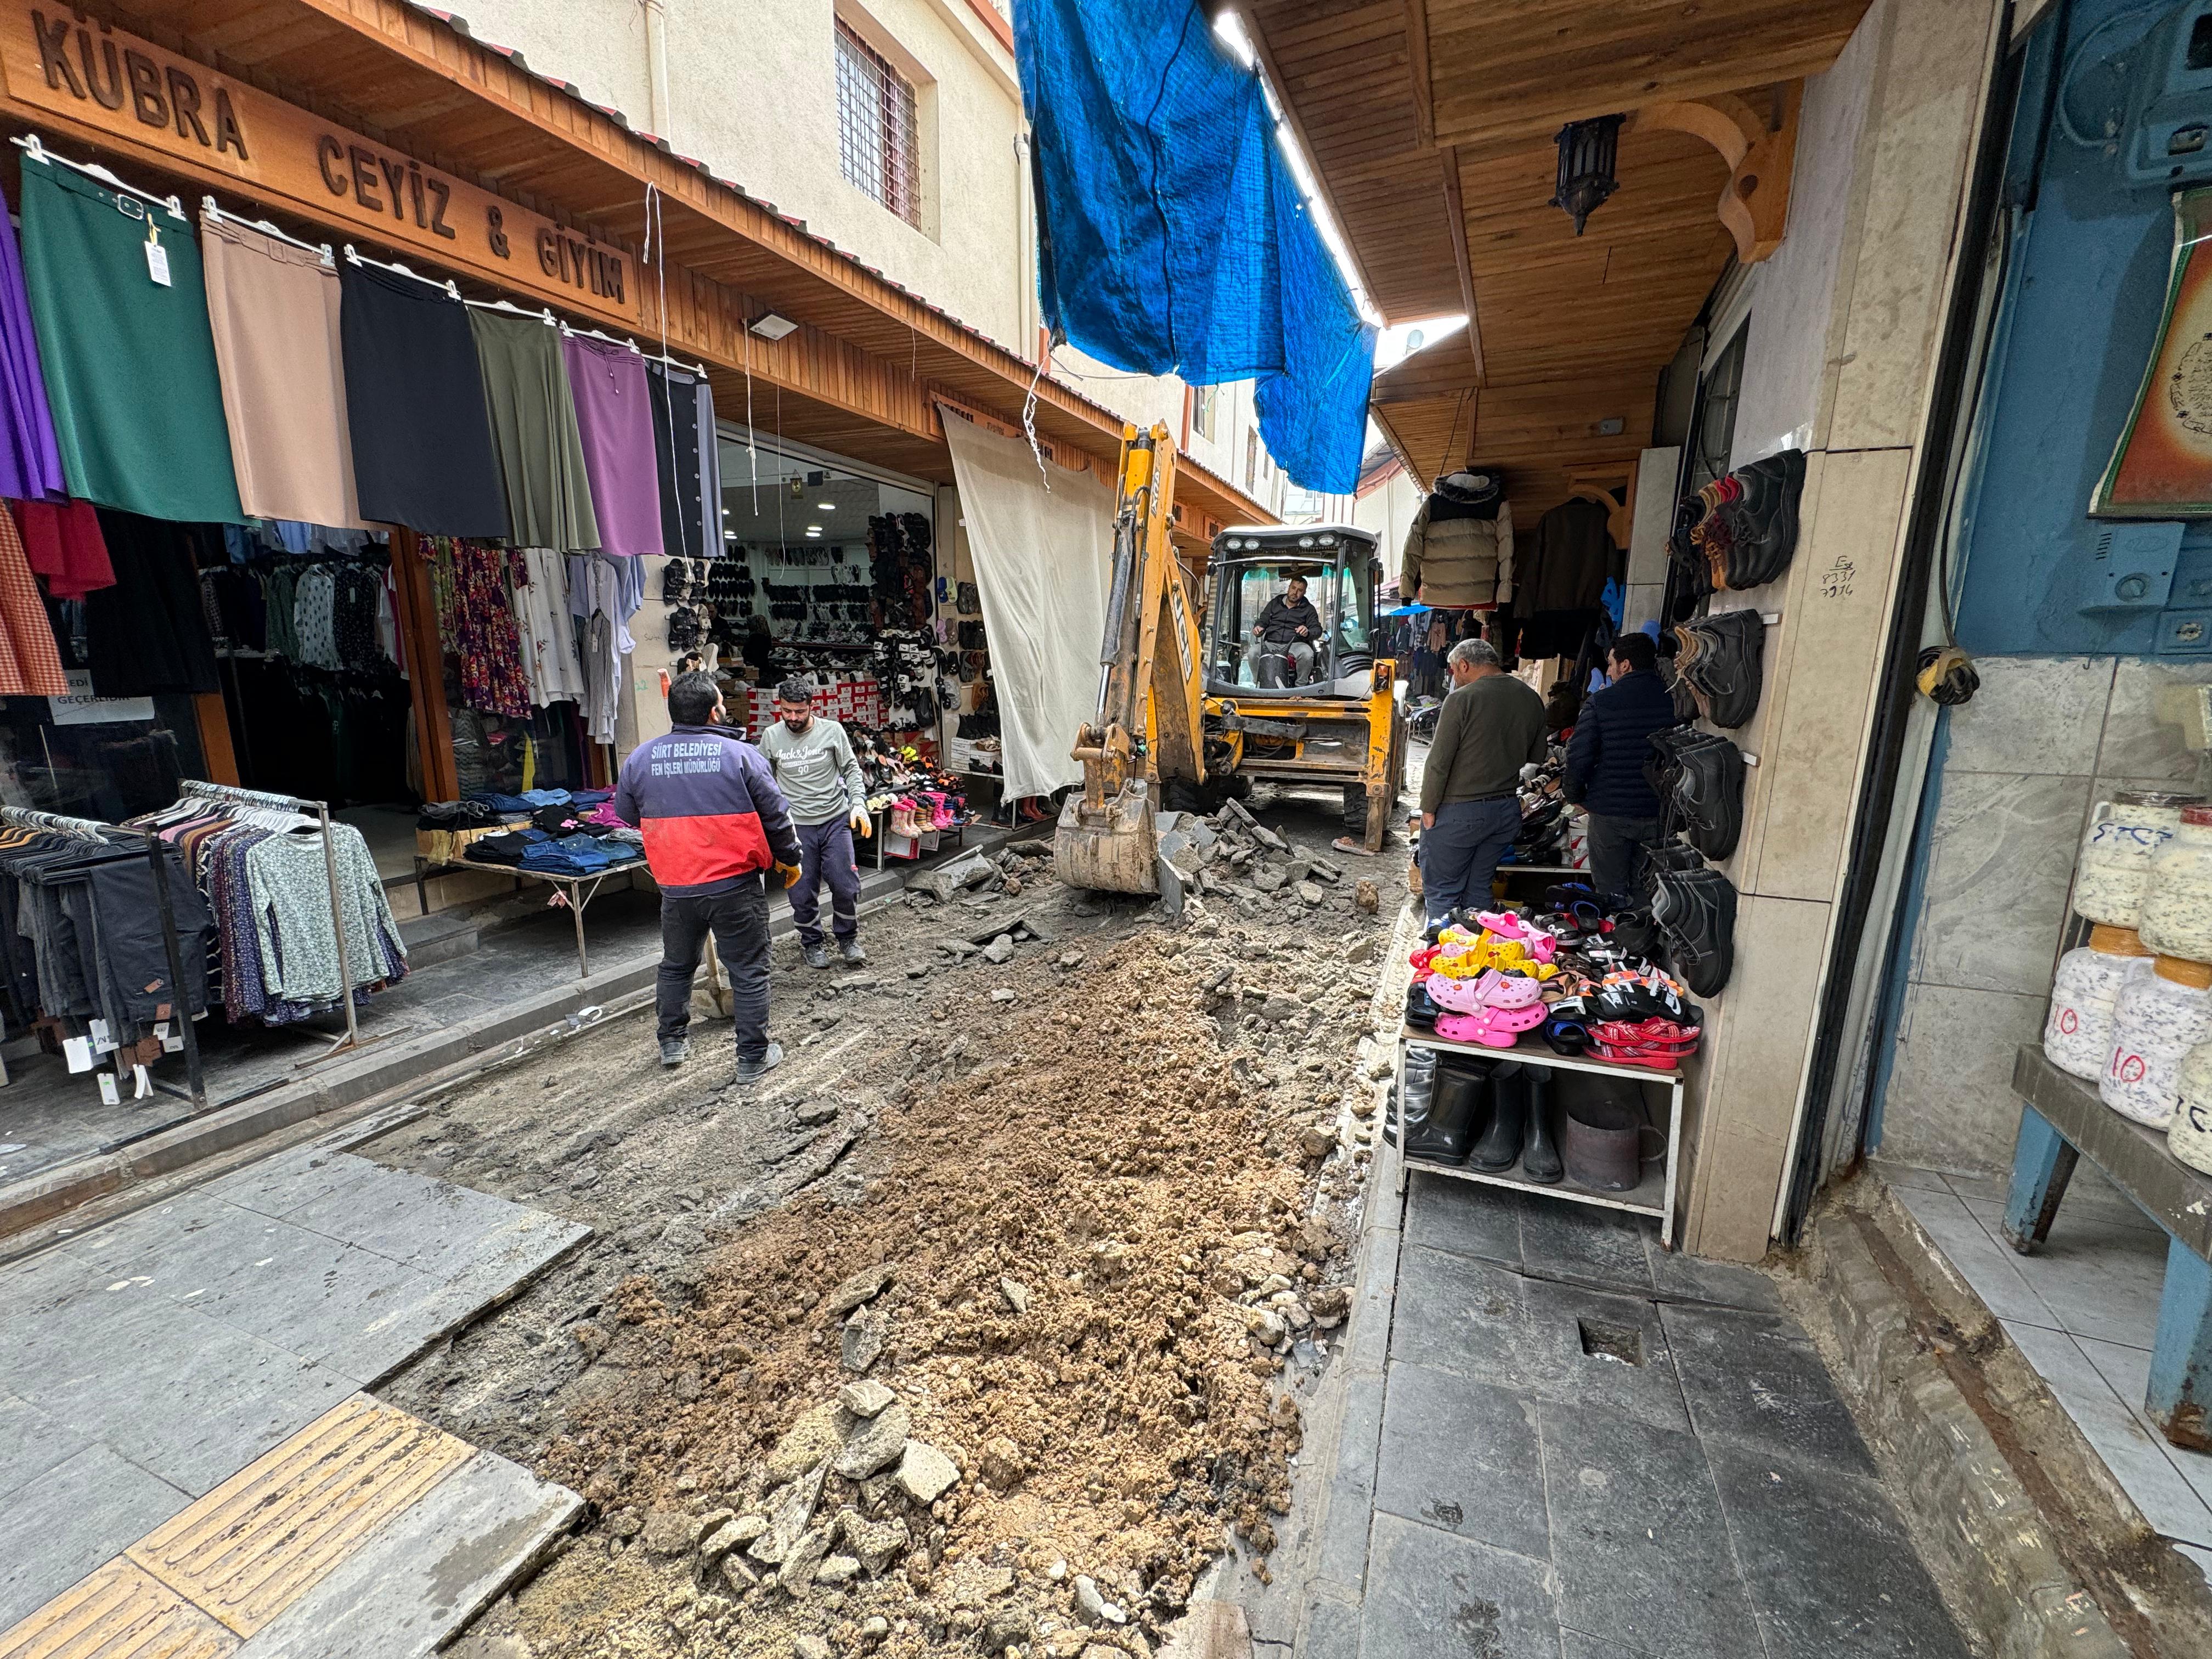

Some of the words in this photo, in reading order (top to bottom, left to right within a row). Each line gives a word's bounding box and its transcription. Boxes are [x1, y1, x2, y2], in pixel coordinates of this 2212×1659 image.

[31, 11, 249, 160] KÜBRA
[318, 134, 456, 239] CEYİZ
[489, 206, 511, 259] &
[538, 225, 625, 304] GİYİM
[1173, 593, 1192, 681] JCB
[69, 677, 89, 687] EDİ
[651, 742, 673, 759] SİİRT
[674, 740, 723, 757] BELEDİYESİ
[651, 763, 663, 776] FEN
[664, 759, 683, 778] İŞLERİ
[684, 758, 721, 774] MÜDÜRLÜĞÜ
[798, 765, 809, 775] 90
[2053, 1004, 2078, 1034] 10
[2112, 1046, 2146, 1082] 10
